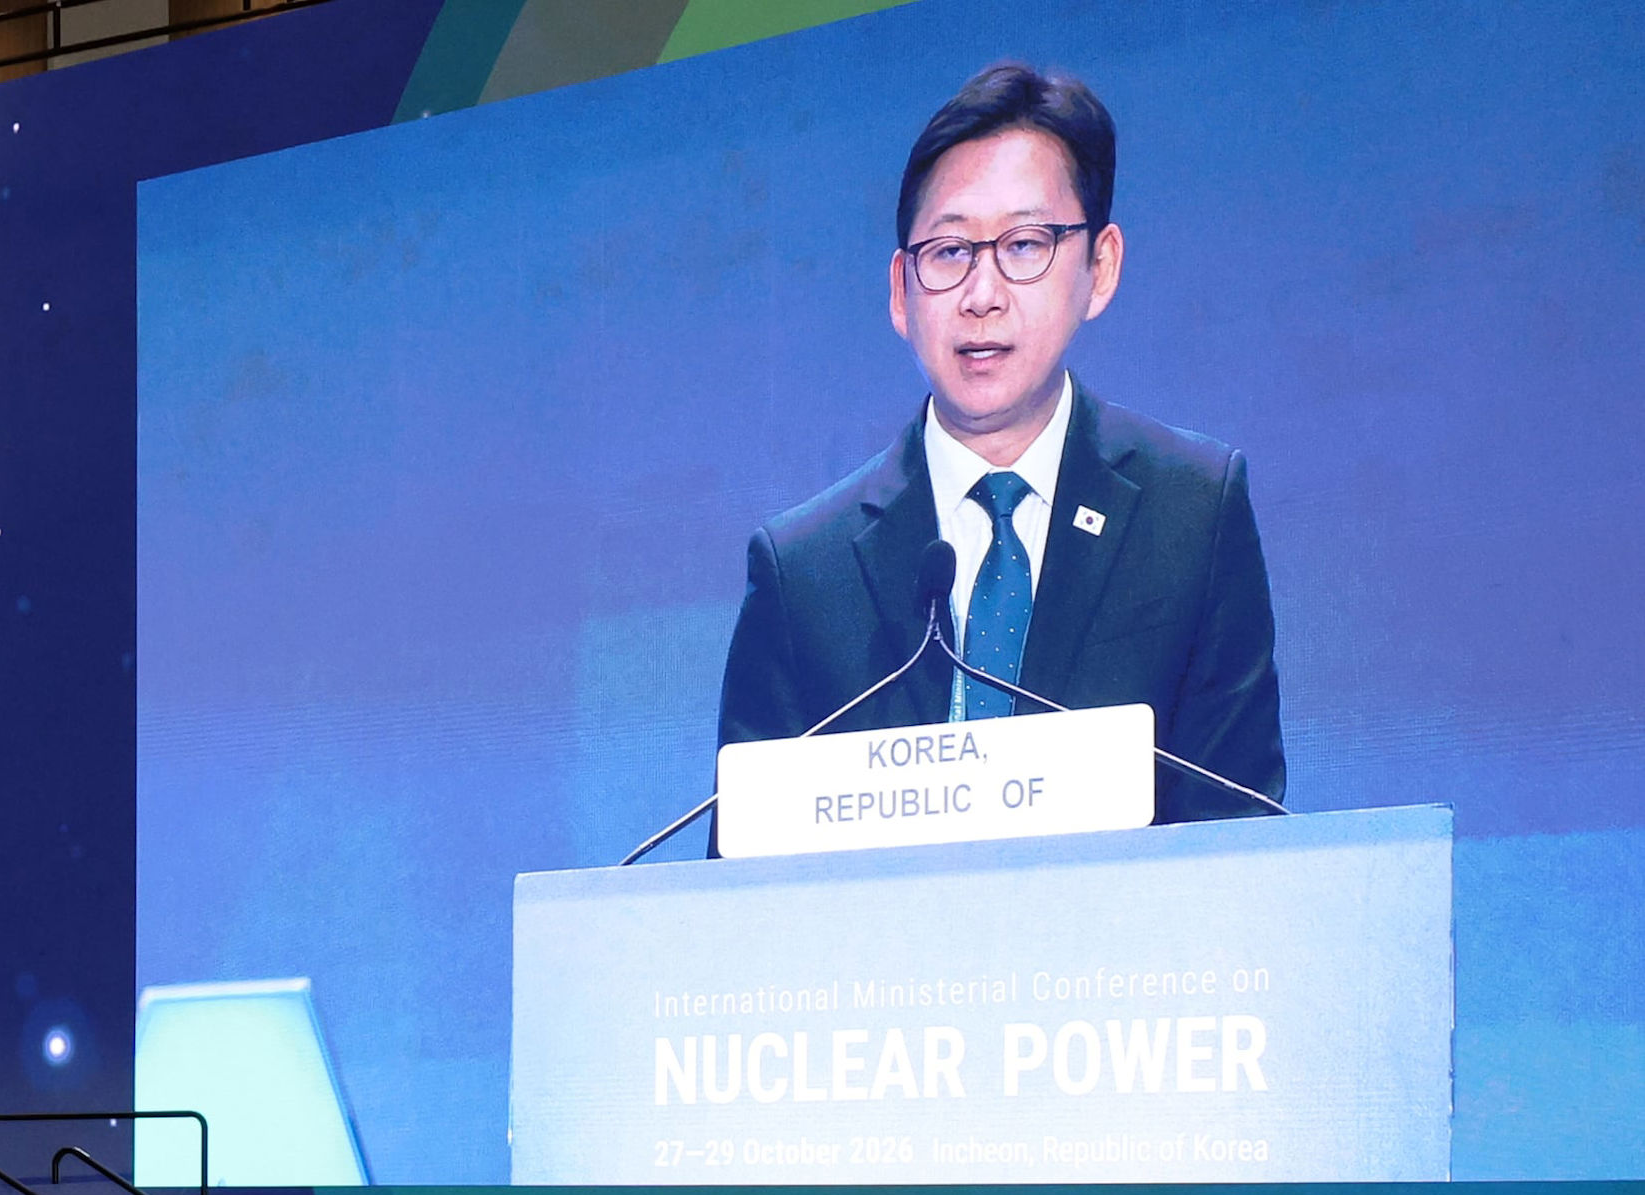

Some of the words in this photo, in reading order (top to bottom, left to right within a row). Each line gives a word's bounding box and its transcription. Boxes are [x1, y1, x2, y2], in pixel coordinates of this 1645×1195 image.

[866, 730, 988, 770] KOREA,
[815, 782, 973, 825] REPUBLIC
[1001, 777, 1046, 810] OF
[654, 980, 837, 1017] International
[853, 973, 1018, 1009] Ministerial
[1032, 966, 1217, 1002] Conference
[1232, 967, 1271, 993] on
[654, 1025, 966, 1106] NUCLEAR
[1003, 1014, 1270, 1097] POWER
[742, 1136, 842, 1166] October
[933, 1136, 1038, 1168] Incheon,
[1043, 1133, 1152, 1167] Republic
[1158, 1133, 1186, 1161] of
[1193, 1133, 1270, 1161] Korea
